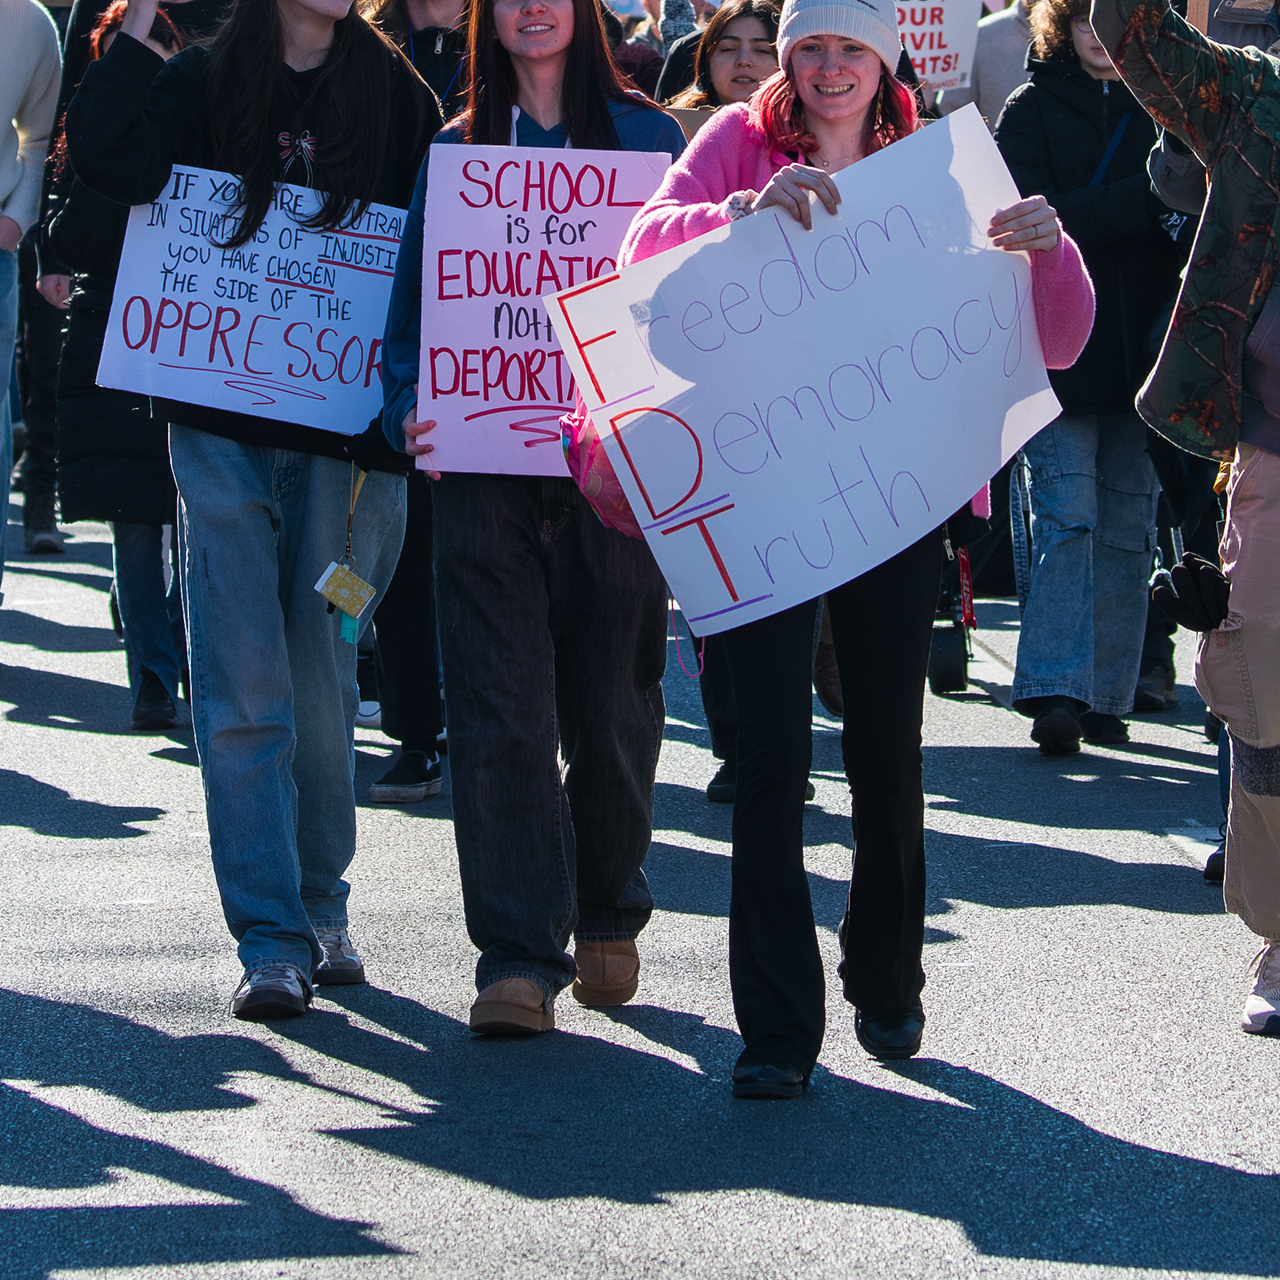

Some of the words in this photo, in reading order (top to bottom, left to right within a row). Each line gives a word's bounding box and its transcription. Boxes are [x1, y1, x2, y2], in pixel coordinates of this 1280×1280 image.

[169, 171, 199, 201] IF
[458, 159, 646, 215] SCHOOL
[146, 201, 168, 229] IN
[278, 227, 308, 251] OF
[317, 234, 397, 271] INJUSTI
[506, 213, 531, 245] is
[540, 214, 597, 246] for
[162, 240, 211, 271] YOU
[221, 248, 260, 275] HAVE
[267, 255, 336, 289] CHOSEN
[160, 269, 199, 293] THE
[213, 276, 259, 303] SIDE
[270, 287, 299, 313] OF
[309, 293, 353, 322] THE
[556, 204, 927, 406] Freedom
[608, 271, 1029, 522] Demoracy
[660, 444, 932, 604] Truth
